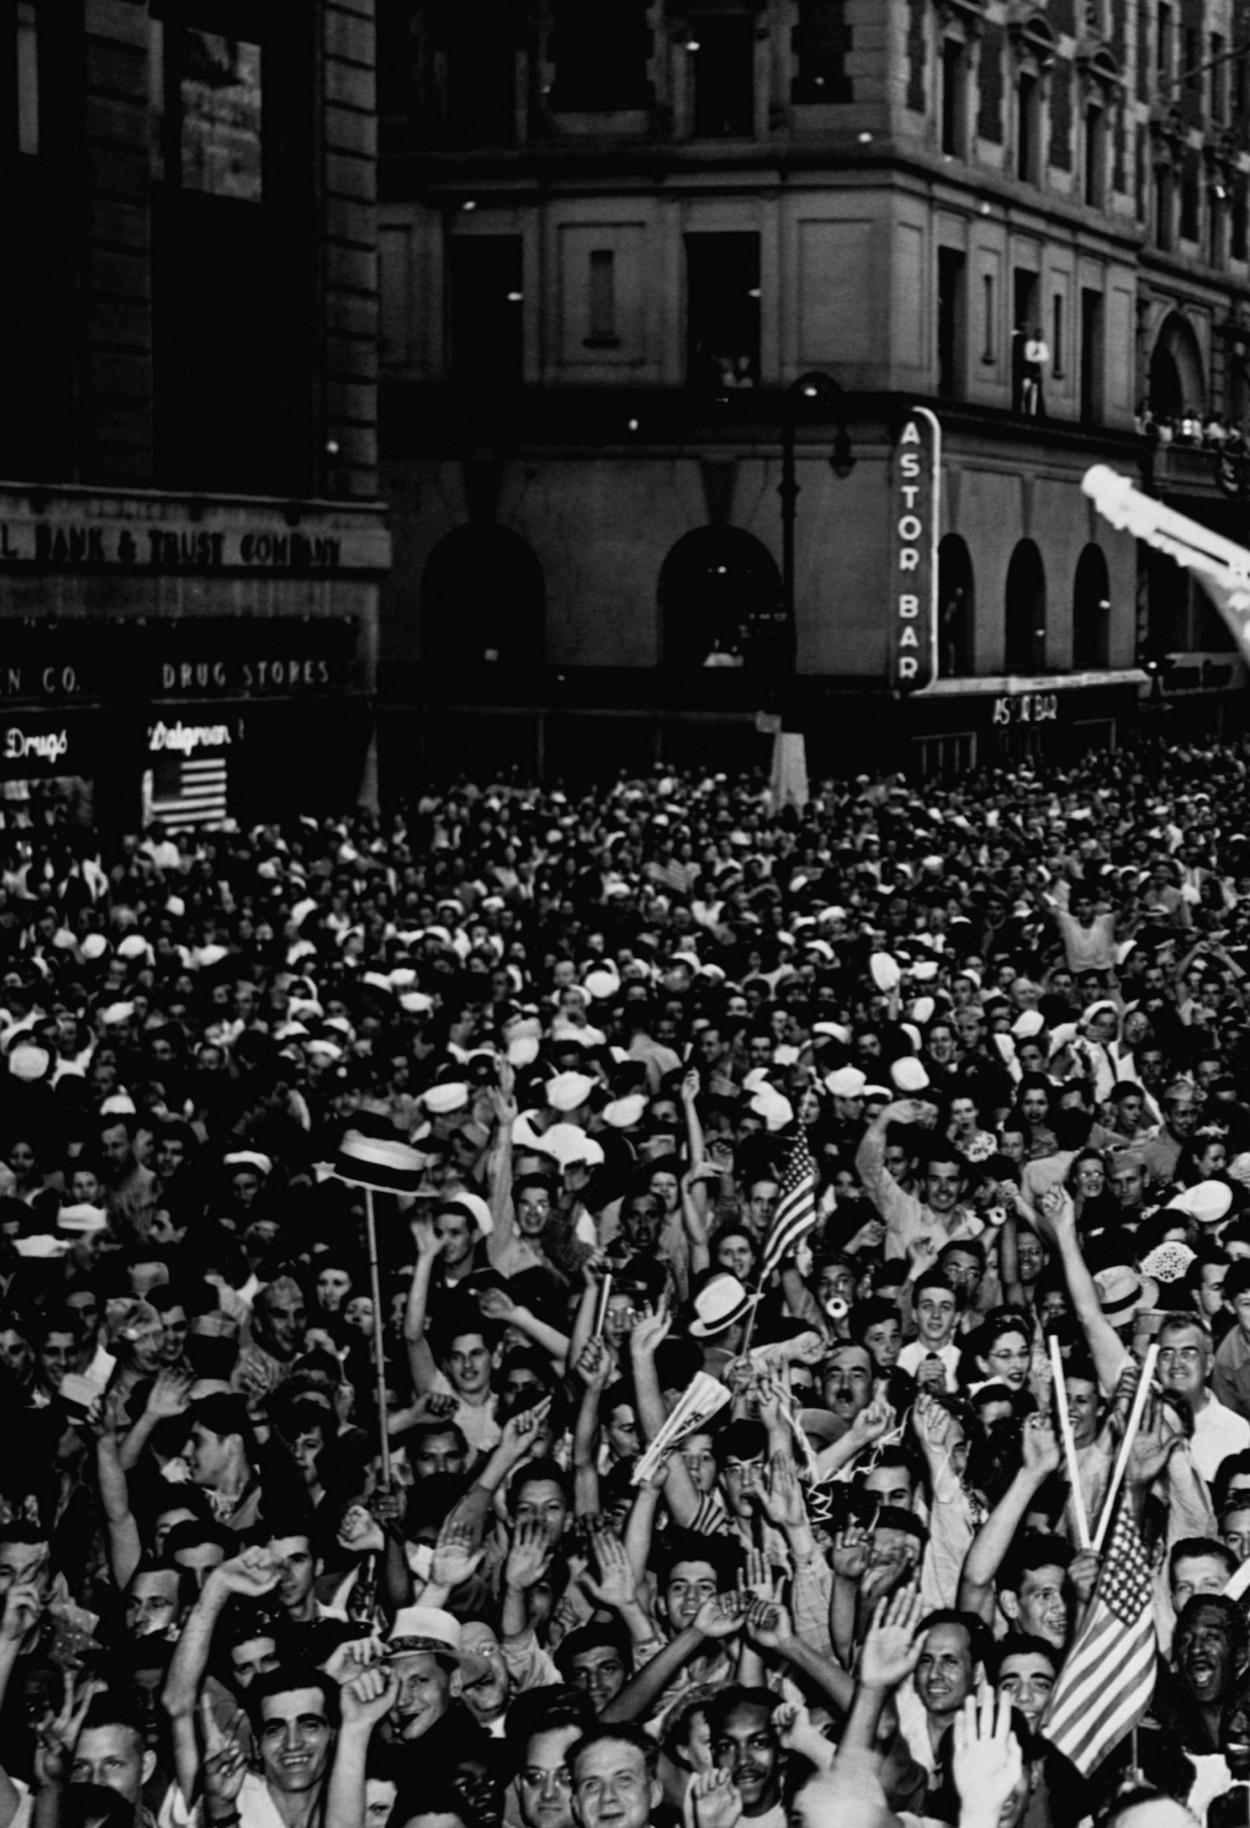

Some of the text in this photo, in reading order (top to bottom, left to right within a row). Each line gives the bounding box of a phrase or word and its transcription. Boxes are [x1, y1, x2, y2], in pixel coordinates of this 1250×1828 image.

[36, 525, 104, 562] BANK
[118, 531, 136, 564] &
[149, 530, 224, 566] TRUST
[240, 533, 341, 568] COMPANY
[898, 422, 922, 679] ASTOR BAR
[42, 665, 81, 694] CO.
[162, 659, 330, 689] DRUG STORES
[2, 727, 68, 764] Drugs
